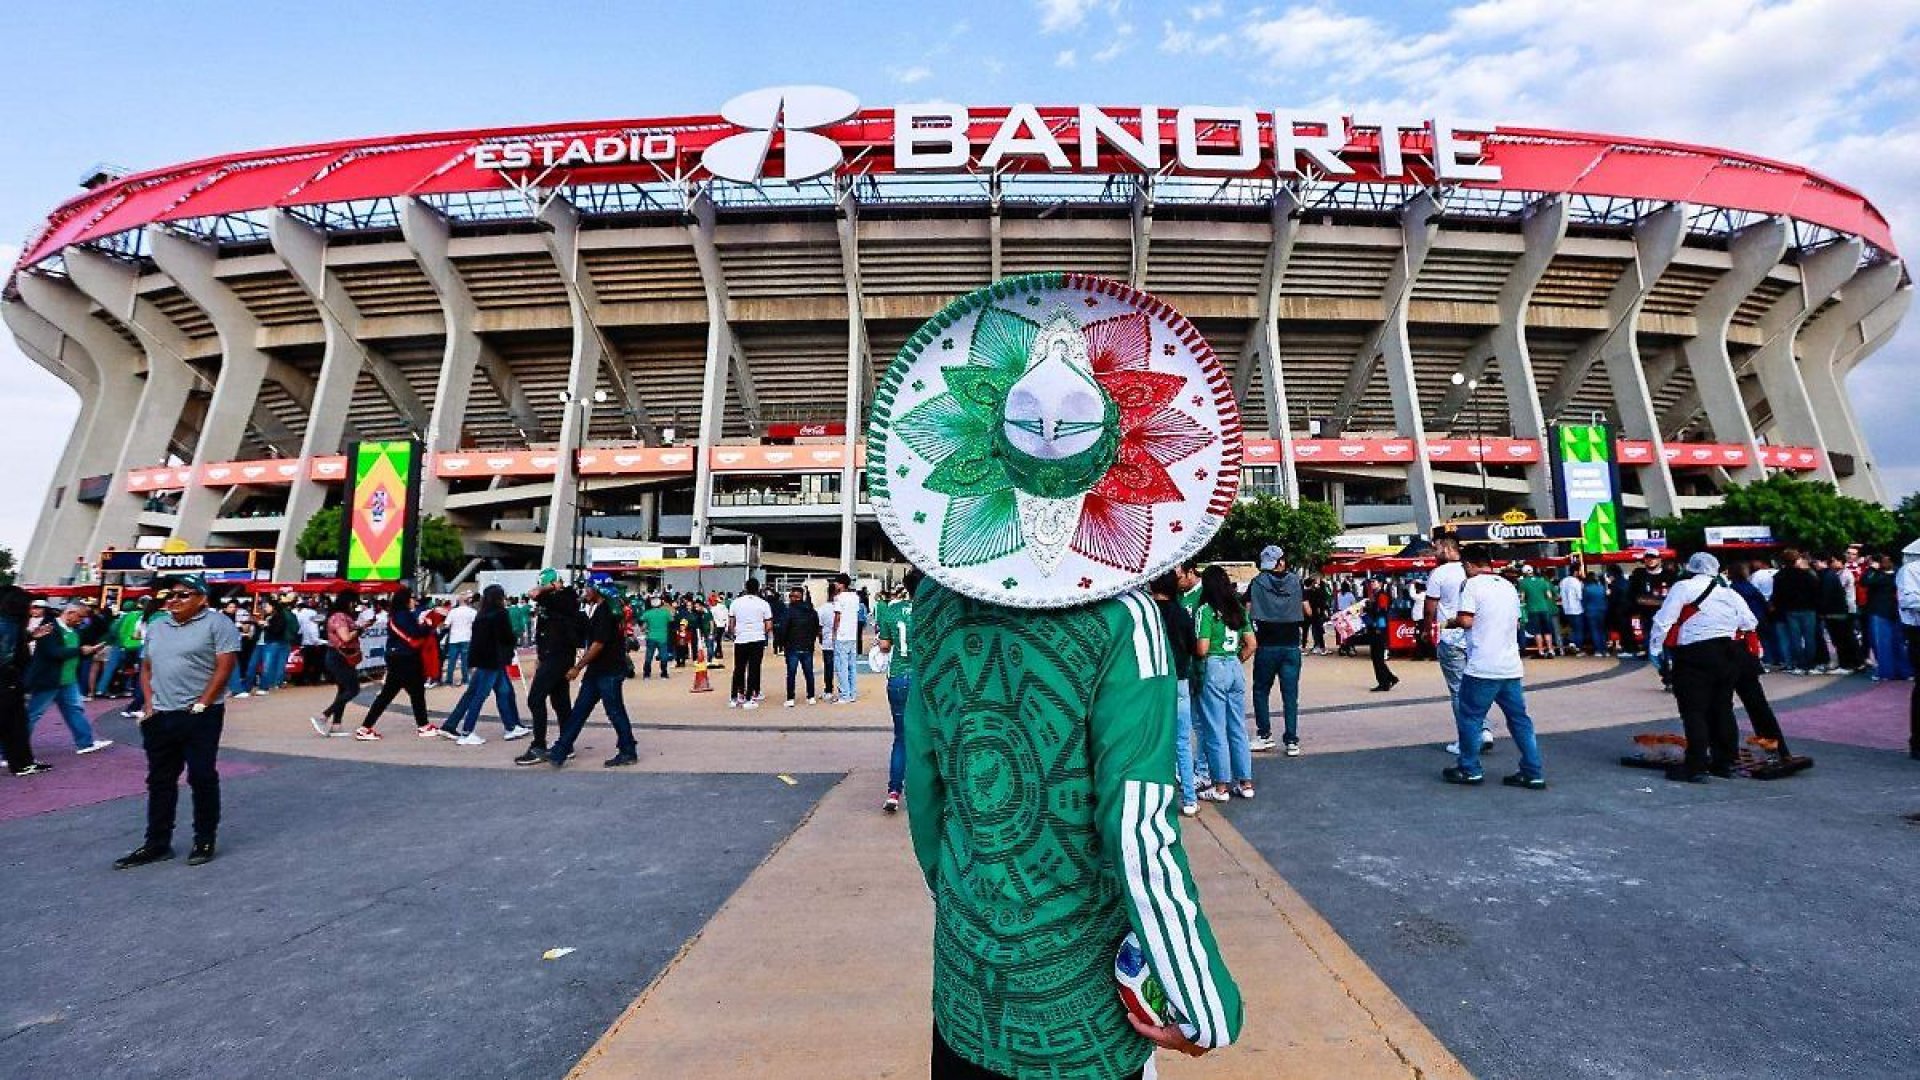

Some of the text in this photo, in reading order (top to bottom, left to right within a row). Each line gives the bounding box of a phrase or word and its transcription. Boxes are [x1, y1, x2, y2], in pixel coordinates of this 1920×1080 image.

[475, 103, 1503, 183] ESTADIO BANORTE
[1487, 522, 1545, 541] Corona
[140, 551, 206, 571] Corona
